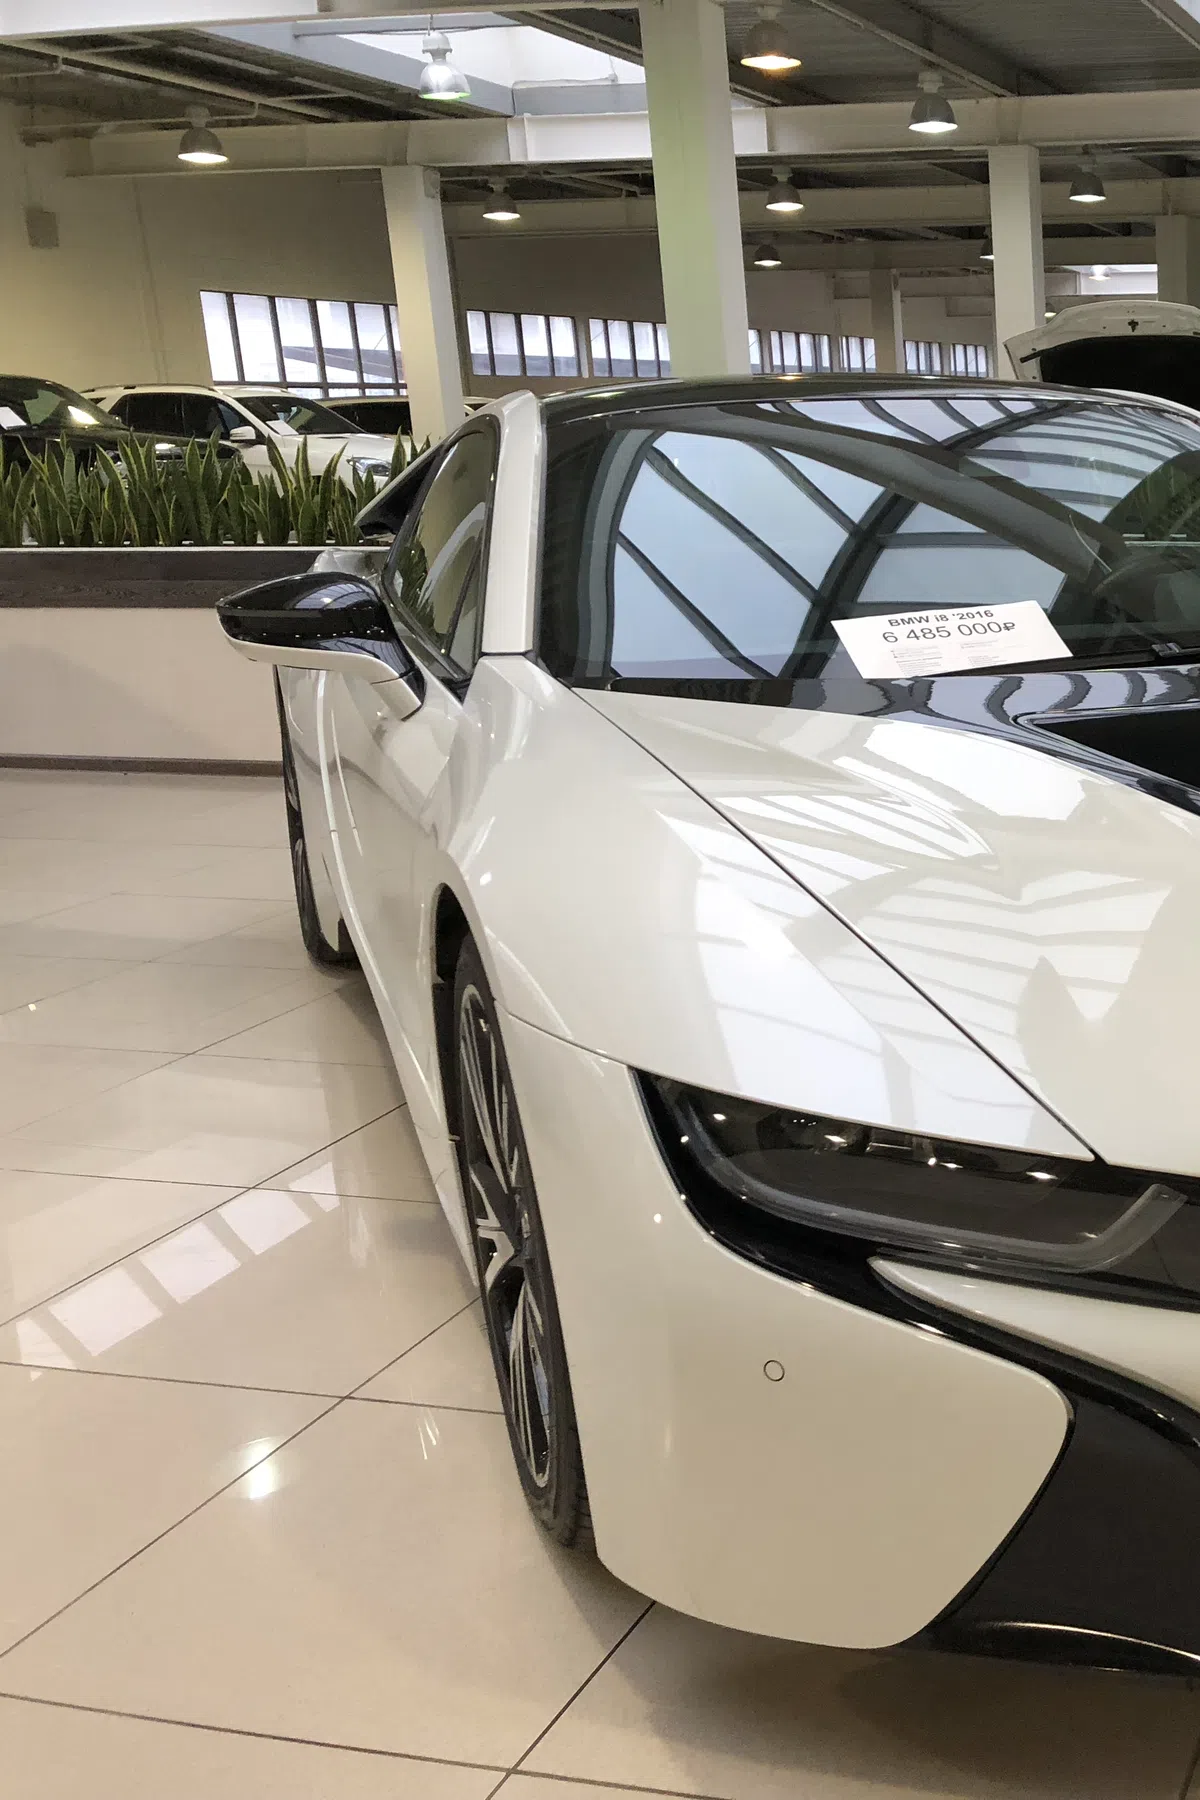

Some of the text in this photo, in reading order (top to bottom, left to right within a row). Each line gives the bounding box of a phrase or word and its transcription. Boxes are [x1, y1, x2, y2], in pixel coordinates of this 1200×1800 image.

[888, 609, 994, 627] BMW i8 '2016
[882, 631, 899, 644] 6
[906, 625, 952, 641] 485
